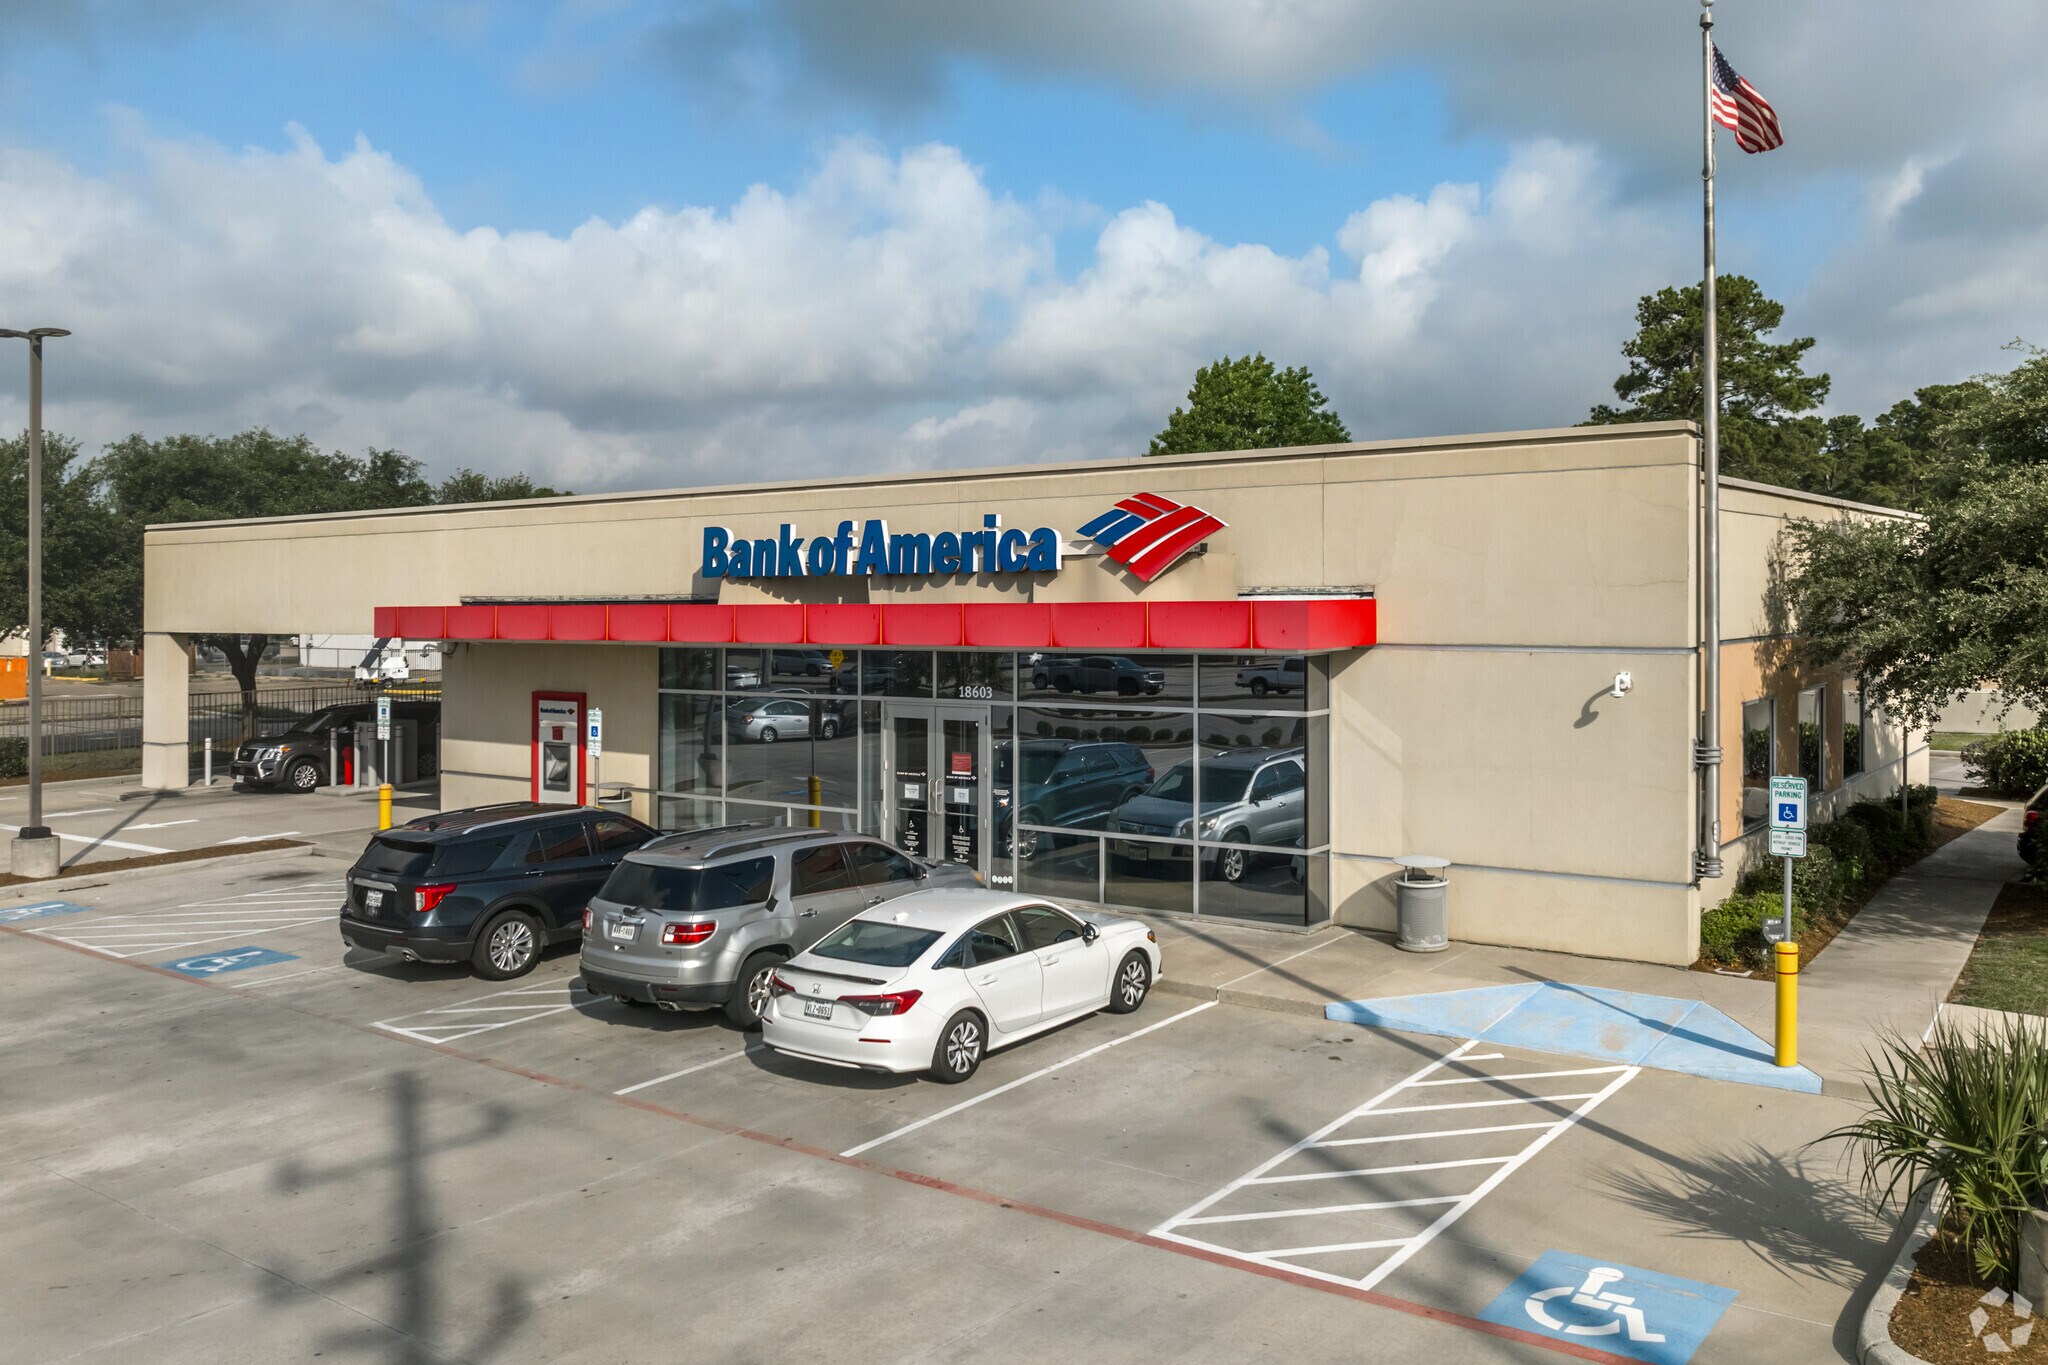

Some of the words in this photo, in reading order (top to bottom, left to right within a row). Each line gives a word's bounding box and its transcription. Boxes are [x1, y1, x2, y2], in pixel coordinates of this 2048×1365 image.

[702, 523, 808, 578] Bank
[808, 520, 858, 577] of
[856, 514, 1062, 575] America
[959, 685, 993, 699] 18603
[1773, 782, 1804, 790] RESERVED
[1775, 791, 1802, 799] PARKING
